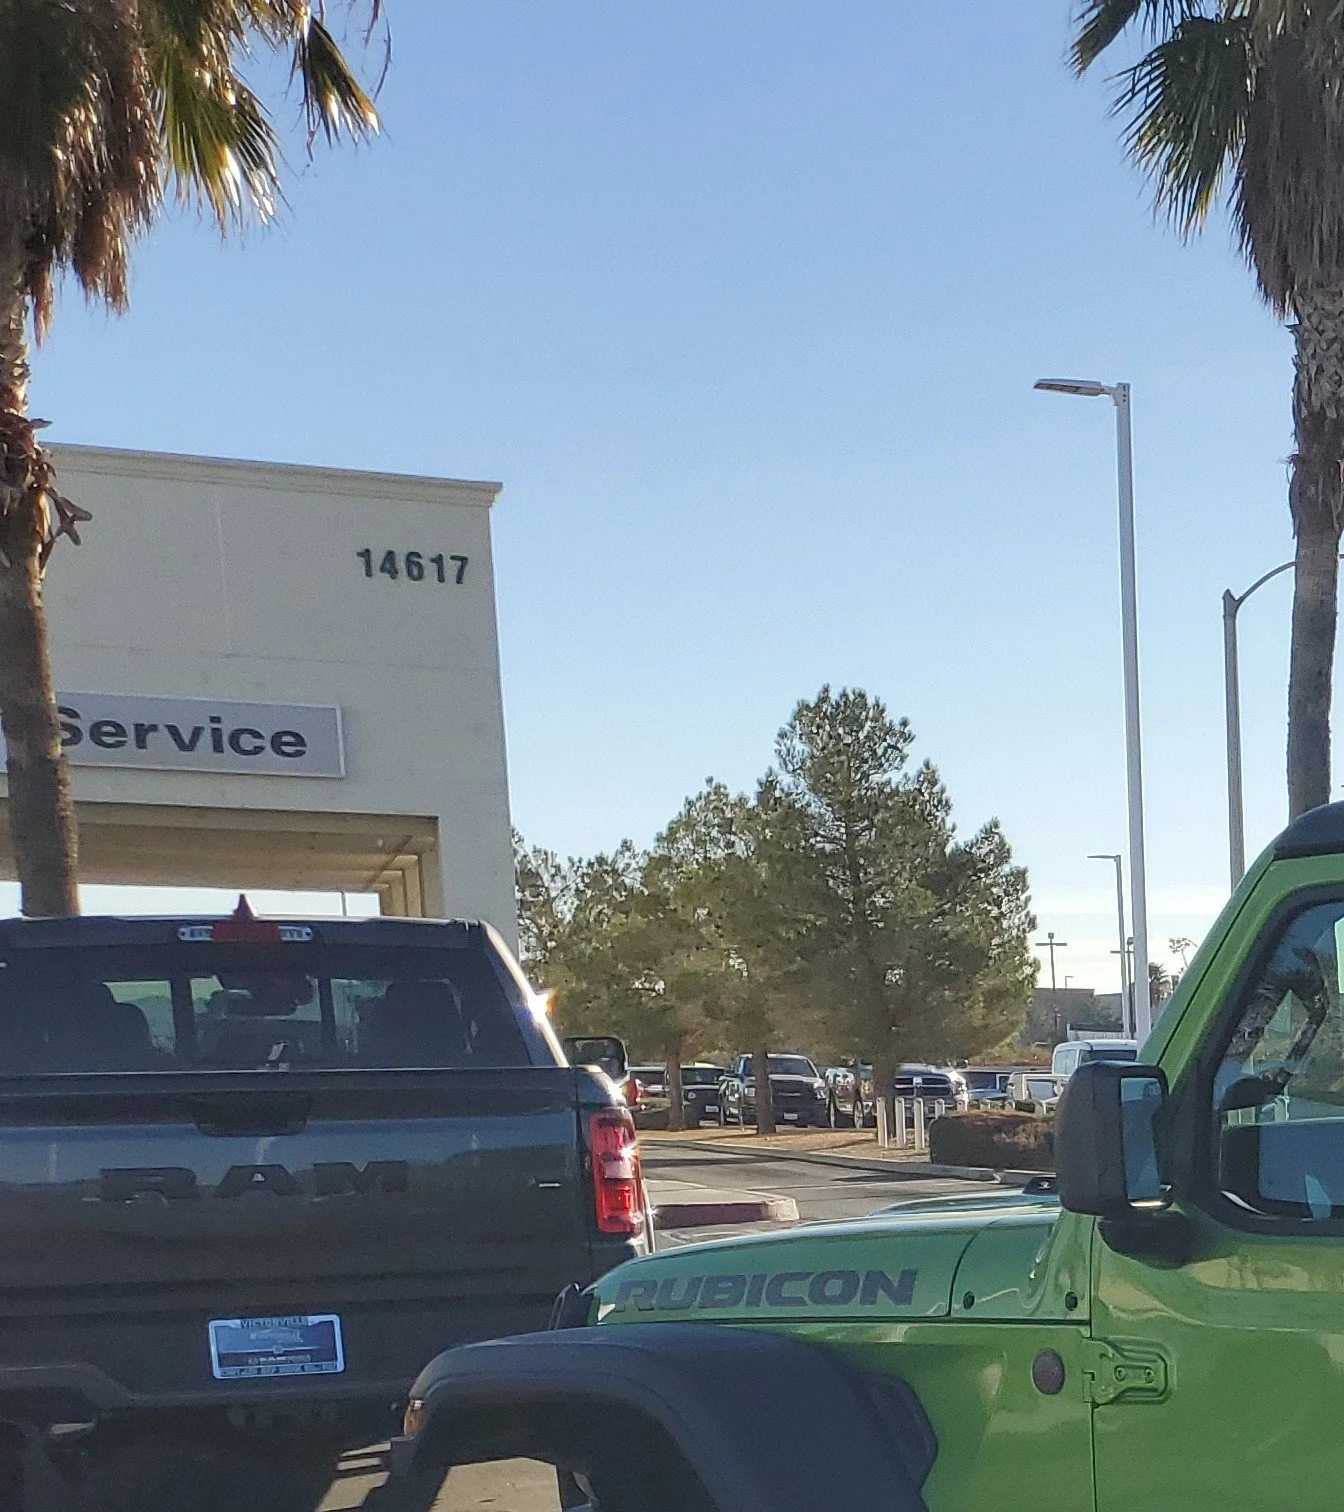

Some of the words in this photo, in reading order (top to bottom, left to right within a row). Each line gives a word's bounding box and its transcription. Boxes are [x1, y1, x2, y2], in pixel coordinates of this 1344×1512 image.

[356, 547, 469, 585] 14617
[57, 705, 308, 760] Service
[99, 1159, 407, 1201] RAM
[614, 1268, 918, 1312] RUBICON
